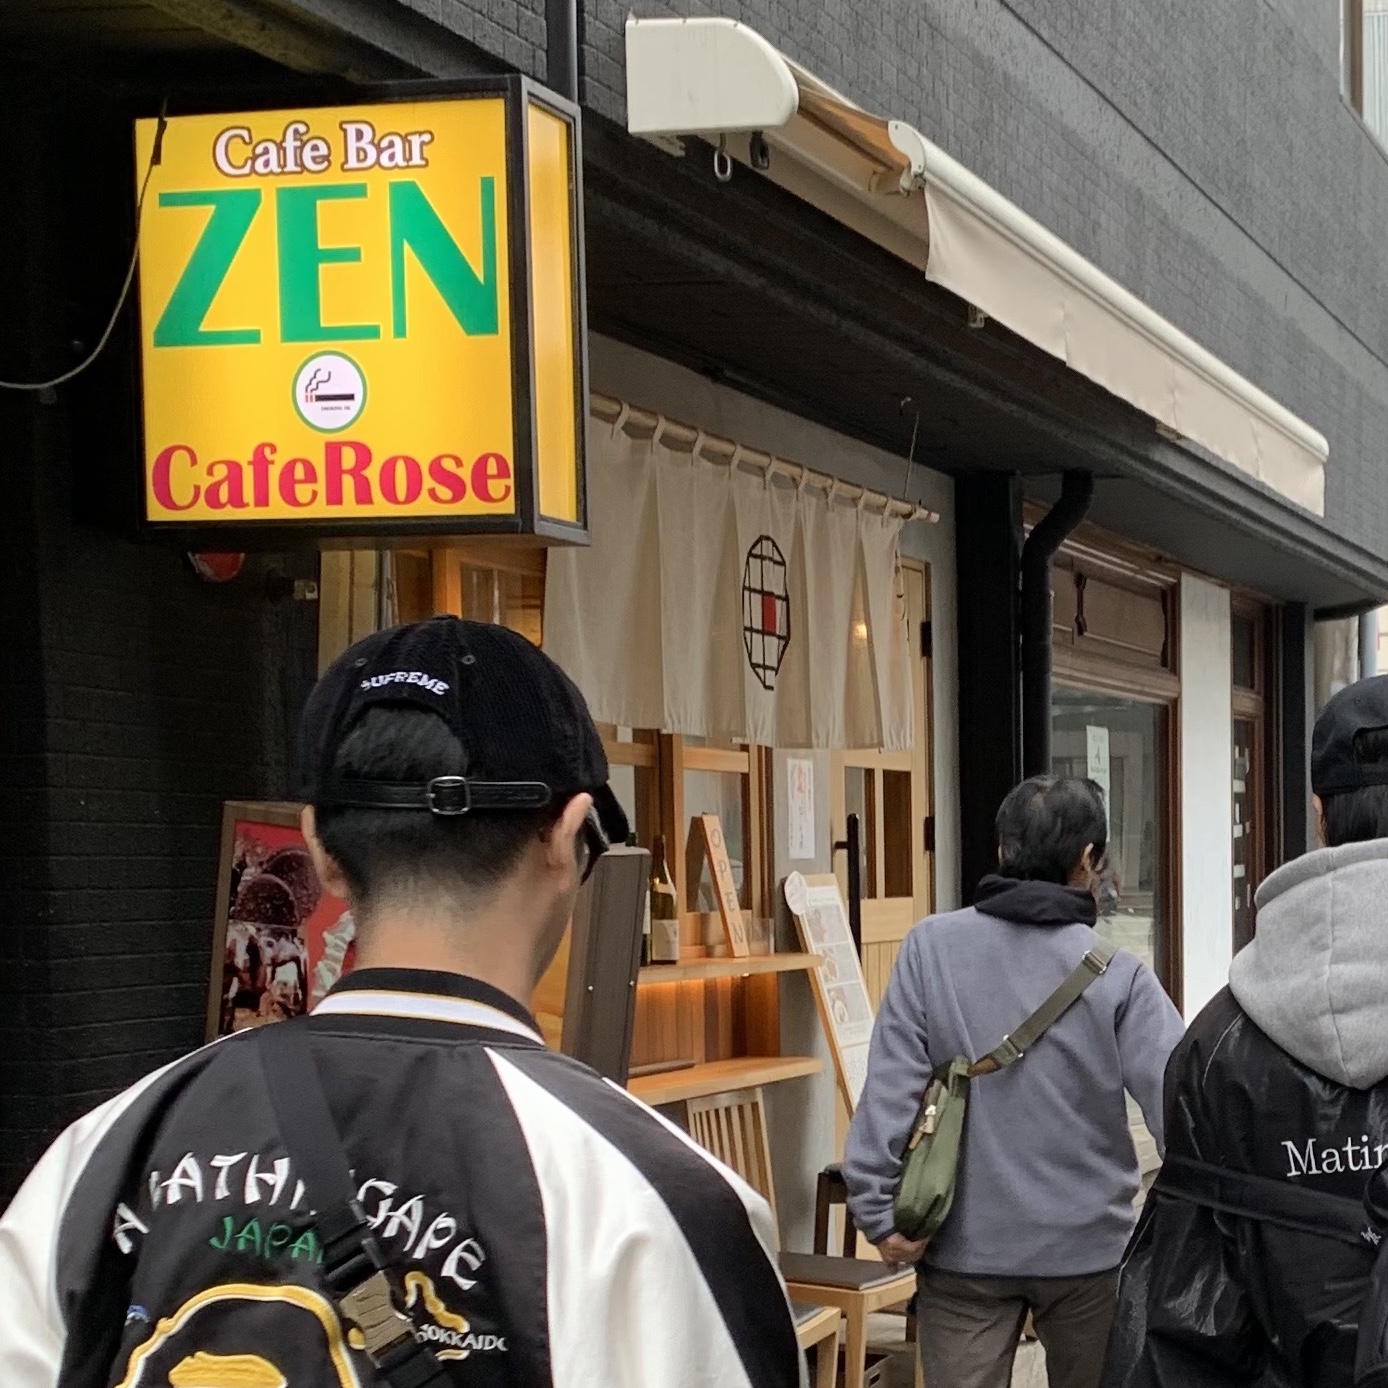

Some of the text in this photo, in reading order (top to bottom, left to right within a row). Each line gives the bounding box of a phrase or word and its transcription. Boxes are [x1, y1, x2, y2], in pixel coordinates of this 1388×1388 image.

[214, 121, 433, 177] Cafe Bar
[153, 176, 499, 347] ZEN
[152, 441, 512, 511] CafeRose
[710, 828, 746, 945] OPEN
[113, 1203, 150, 1255] A
[382, 1194, 487, 1291] APE
[208, 1216, 325, 1265] JAPA
